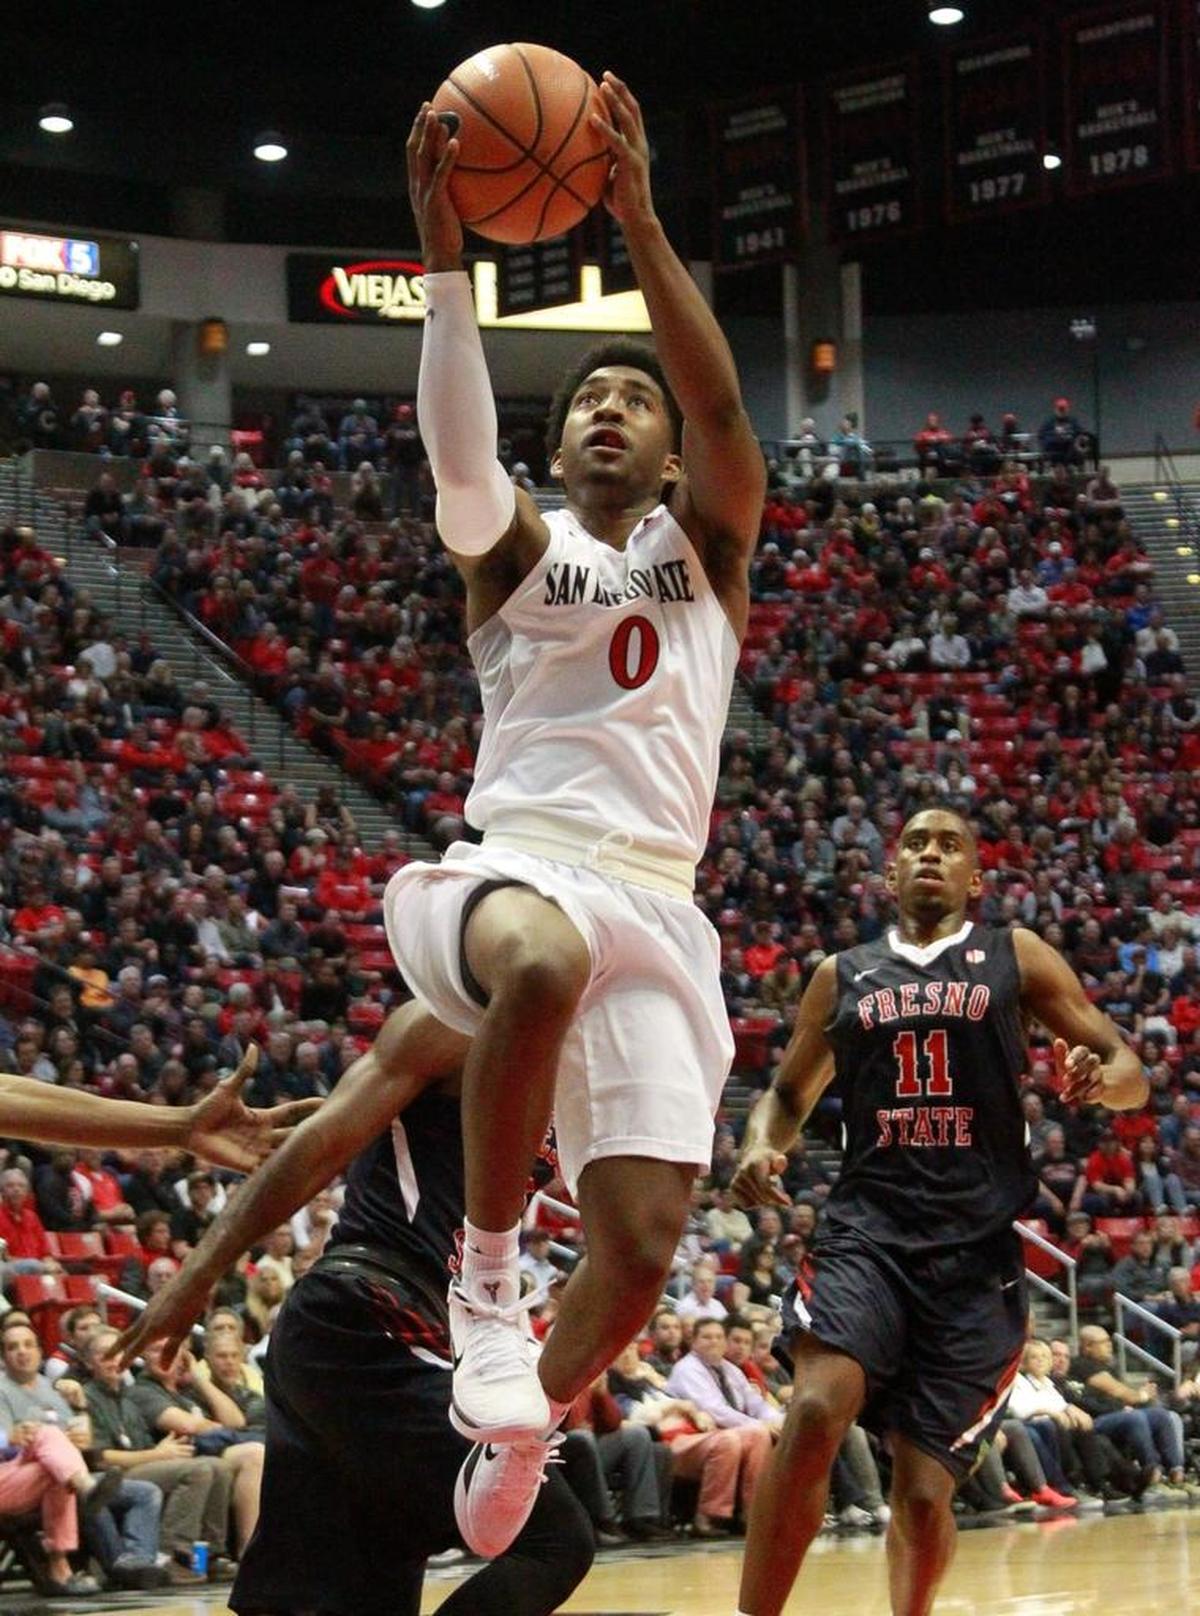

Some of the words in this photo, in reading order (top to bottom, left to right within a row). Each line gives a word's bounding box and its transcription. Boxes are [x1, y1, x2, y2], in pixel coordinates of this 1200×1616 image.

[1089, 145, 1149, 176] 1978
[969, 172, 1026, 203] 1977
[848, 201, 901, 231] 1976
[71, 242, 92, 275] 5
[736, 227, 785, 256] 1941
[18, 268, 56, 291] San
[57, 272, 116, 301] Diego
[333, 267, 427, 307] VIEJAS
[544, 562, 590, 607] SAN
[648, 559, 695, 603] ATE
[609, 615, 660, 690] 0
[857, 981, 990, 1030] FRESNO
[893, 1029, 953, 1098] 11
[876, 1106, 973, 1148] STATE
